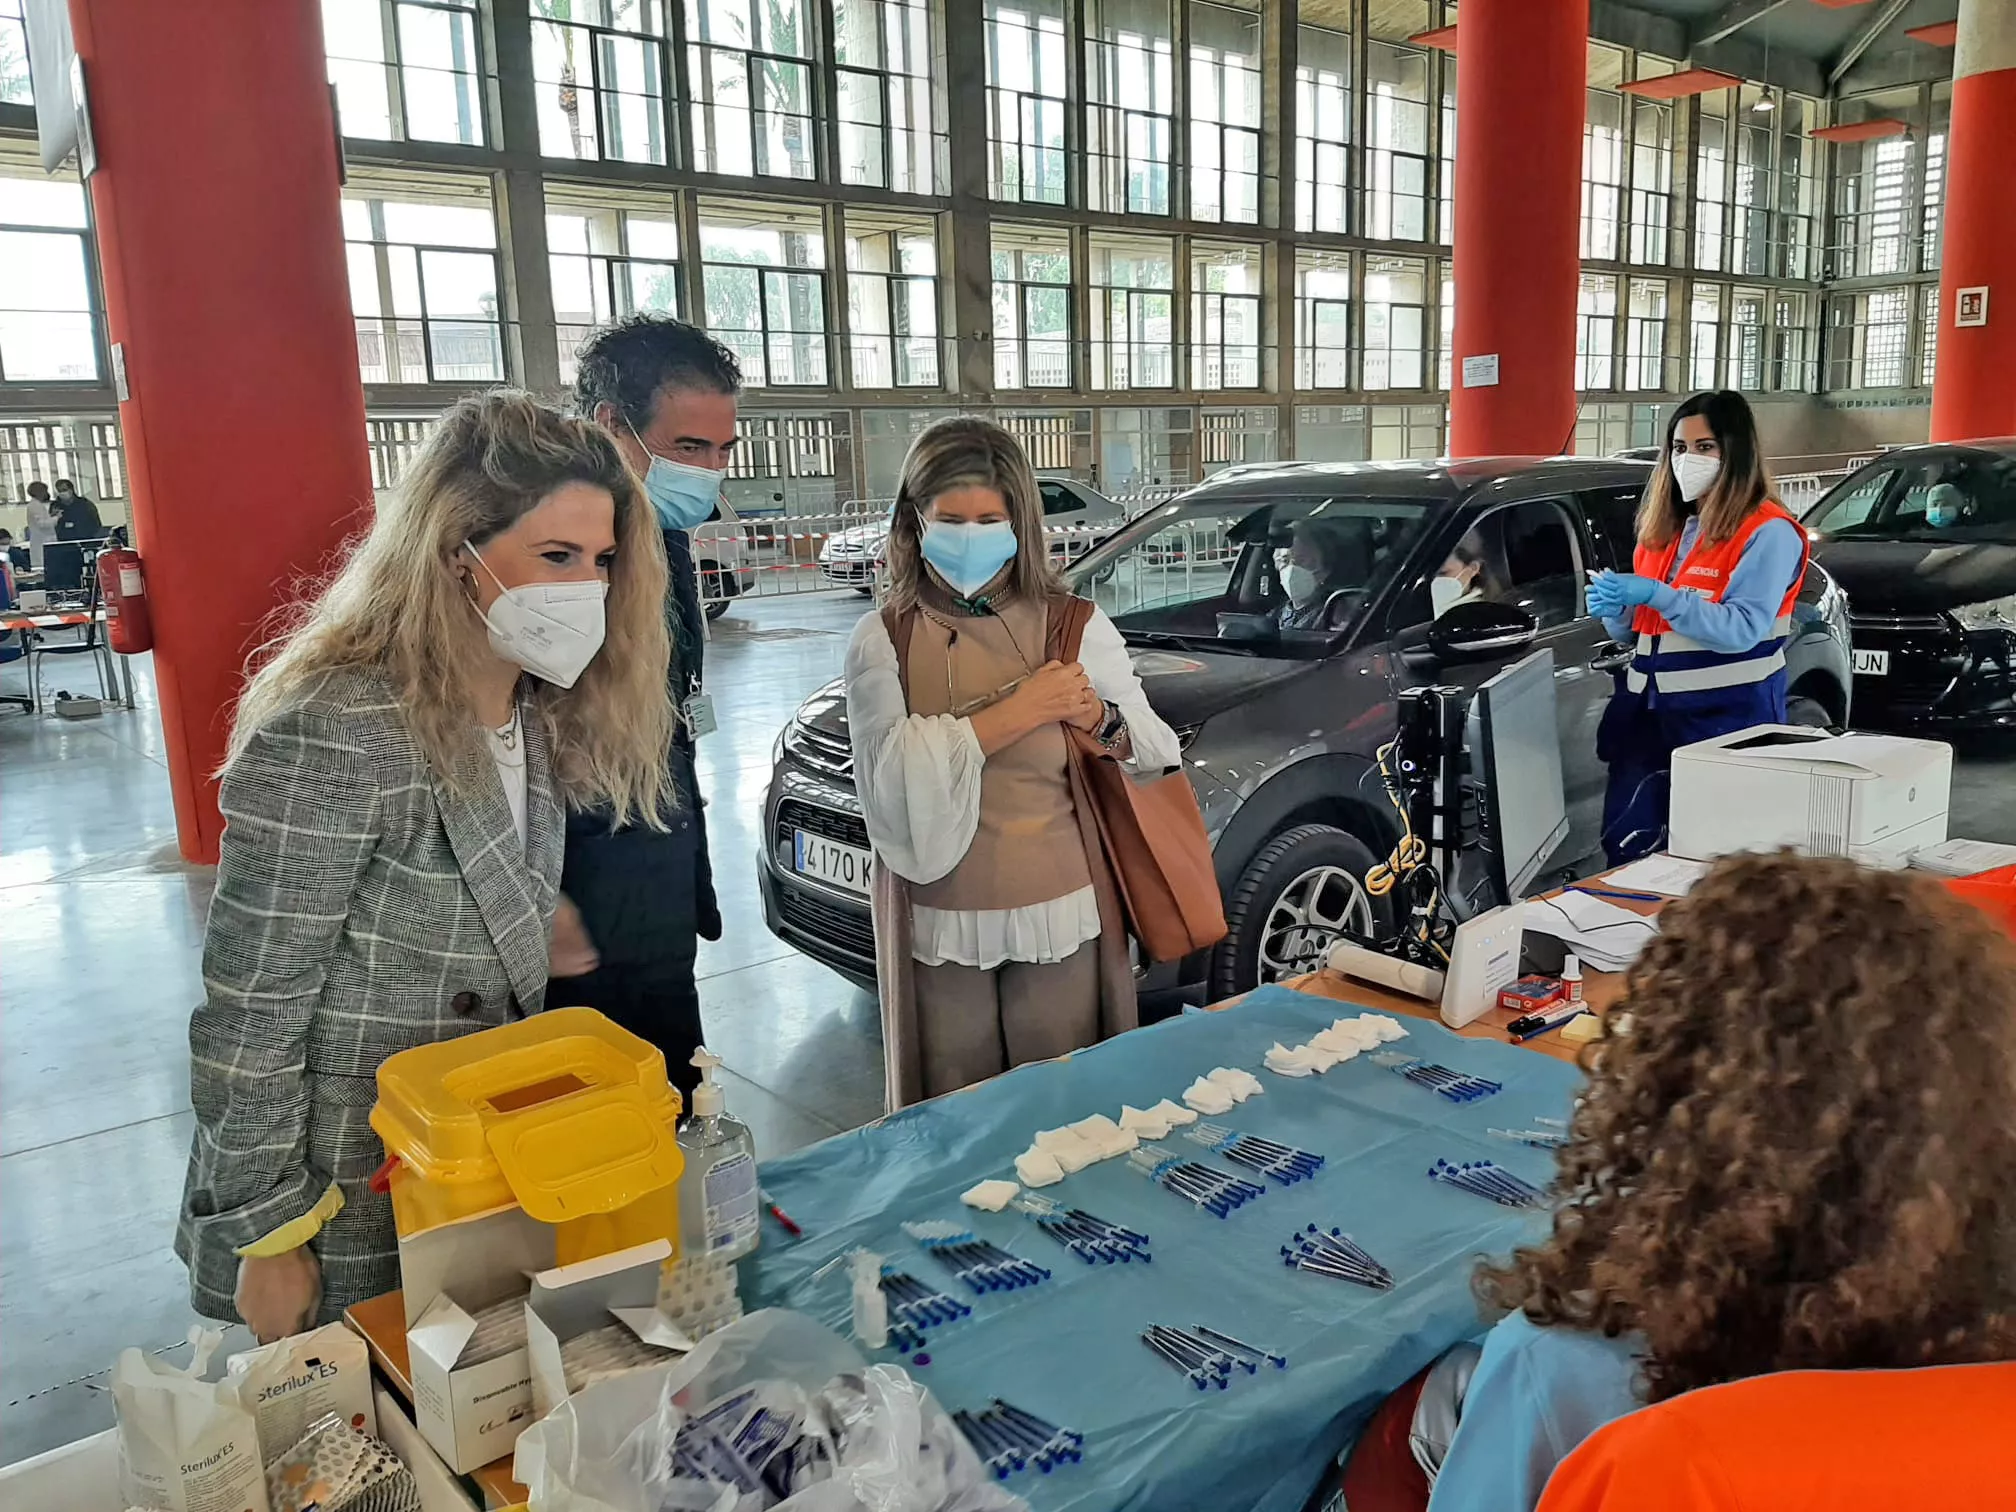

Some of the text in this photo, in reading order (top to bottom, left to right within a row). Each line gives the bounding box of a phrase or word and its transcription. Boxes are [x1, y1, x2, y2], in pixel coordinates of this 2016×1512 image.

[807, 840, 872, 888] 4170 K
[319, 1360, 338, 1378] ES
[222, 1441, 234, 1456] ES
